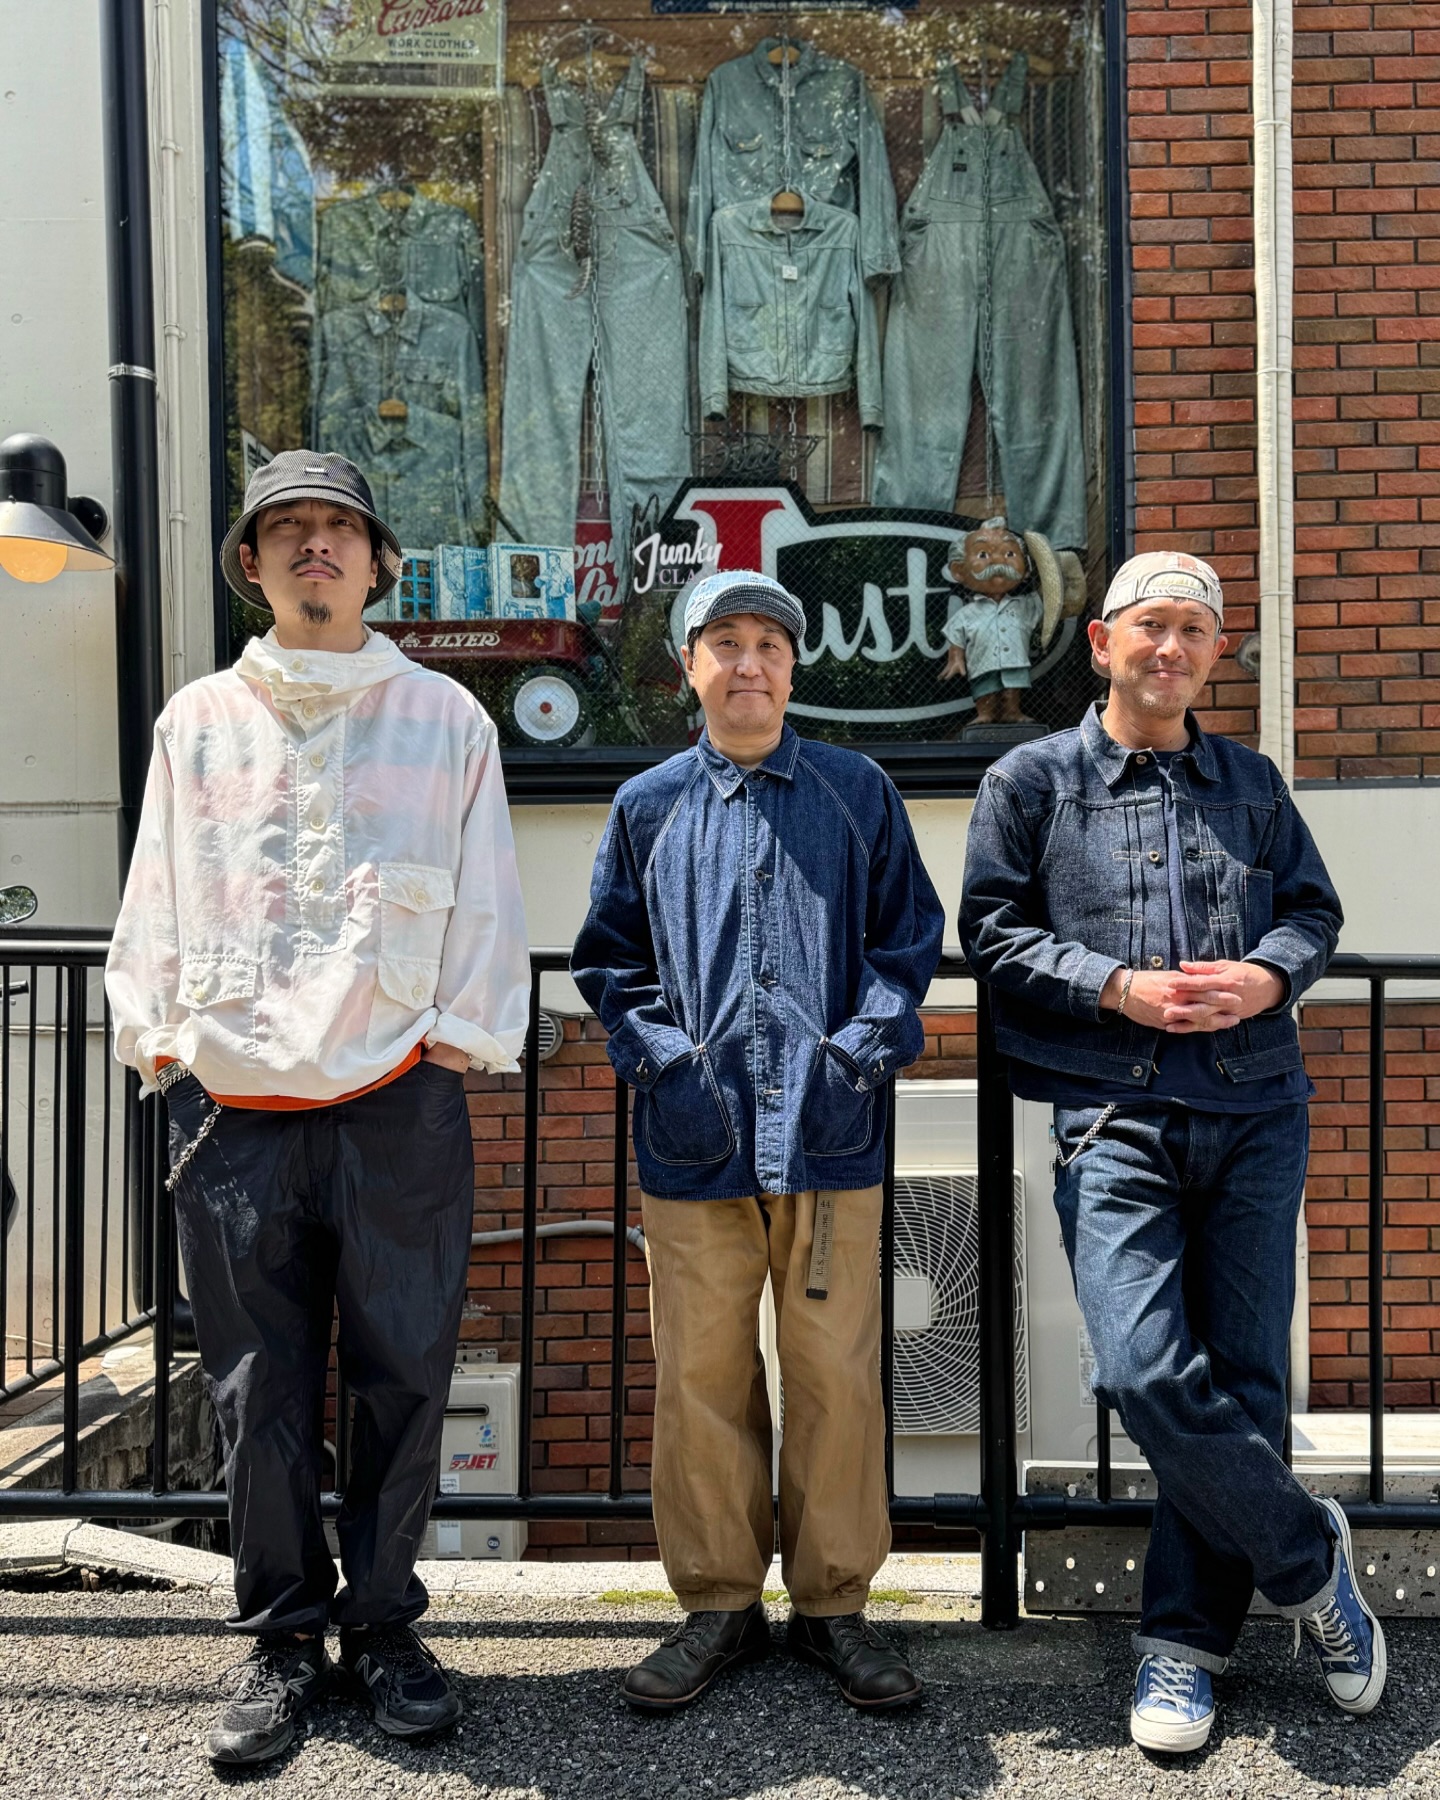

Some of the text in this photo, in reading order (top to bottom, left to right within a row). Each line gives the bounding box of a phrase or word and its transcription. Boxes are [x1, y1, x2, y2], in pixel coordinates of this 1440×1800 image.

[388, 39, 476, 49] WORK CLOTHES
[633, 527, 723, 594] Junky
[428, 631, 501, 648] FLYER
